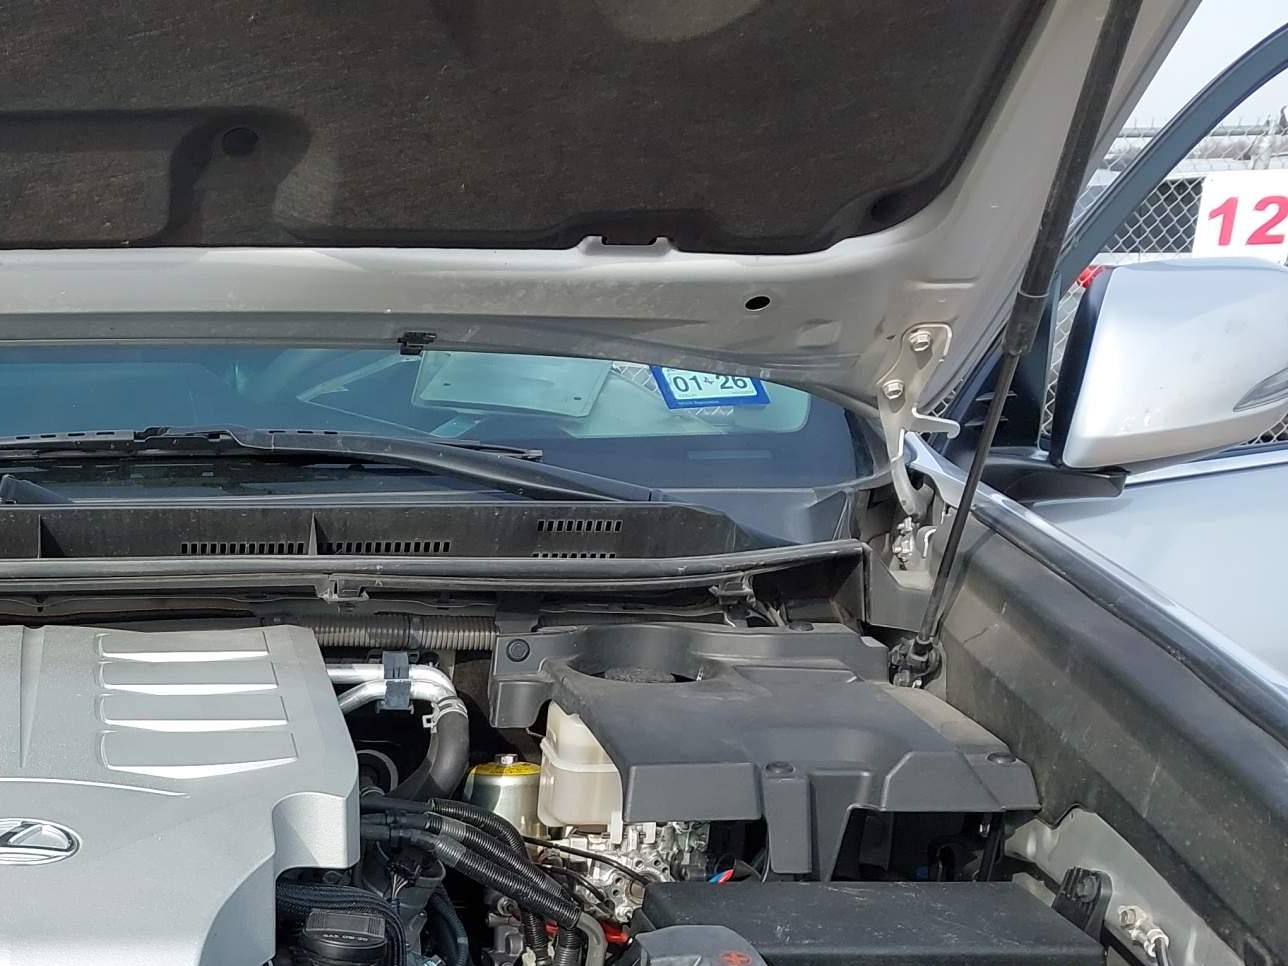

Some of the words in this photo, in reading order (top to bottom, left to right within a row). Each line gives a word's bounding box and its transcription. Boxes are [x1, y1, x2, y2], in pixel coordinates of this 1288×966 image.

[1208, 194, 1288, 246] 12
[672, 375, 703, 392] 01
[716, 374, 748, 390] 26
